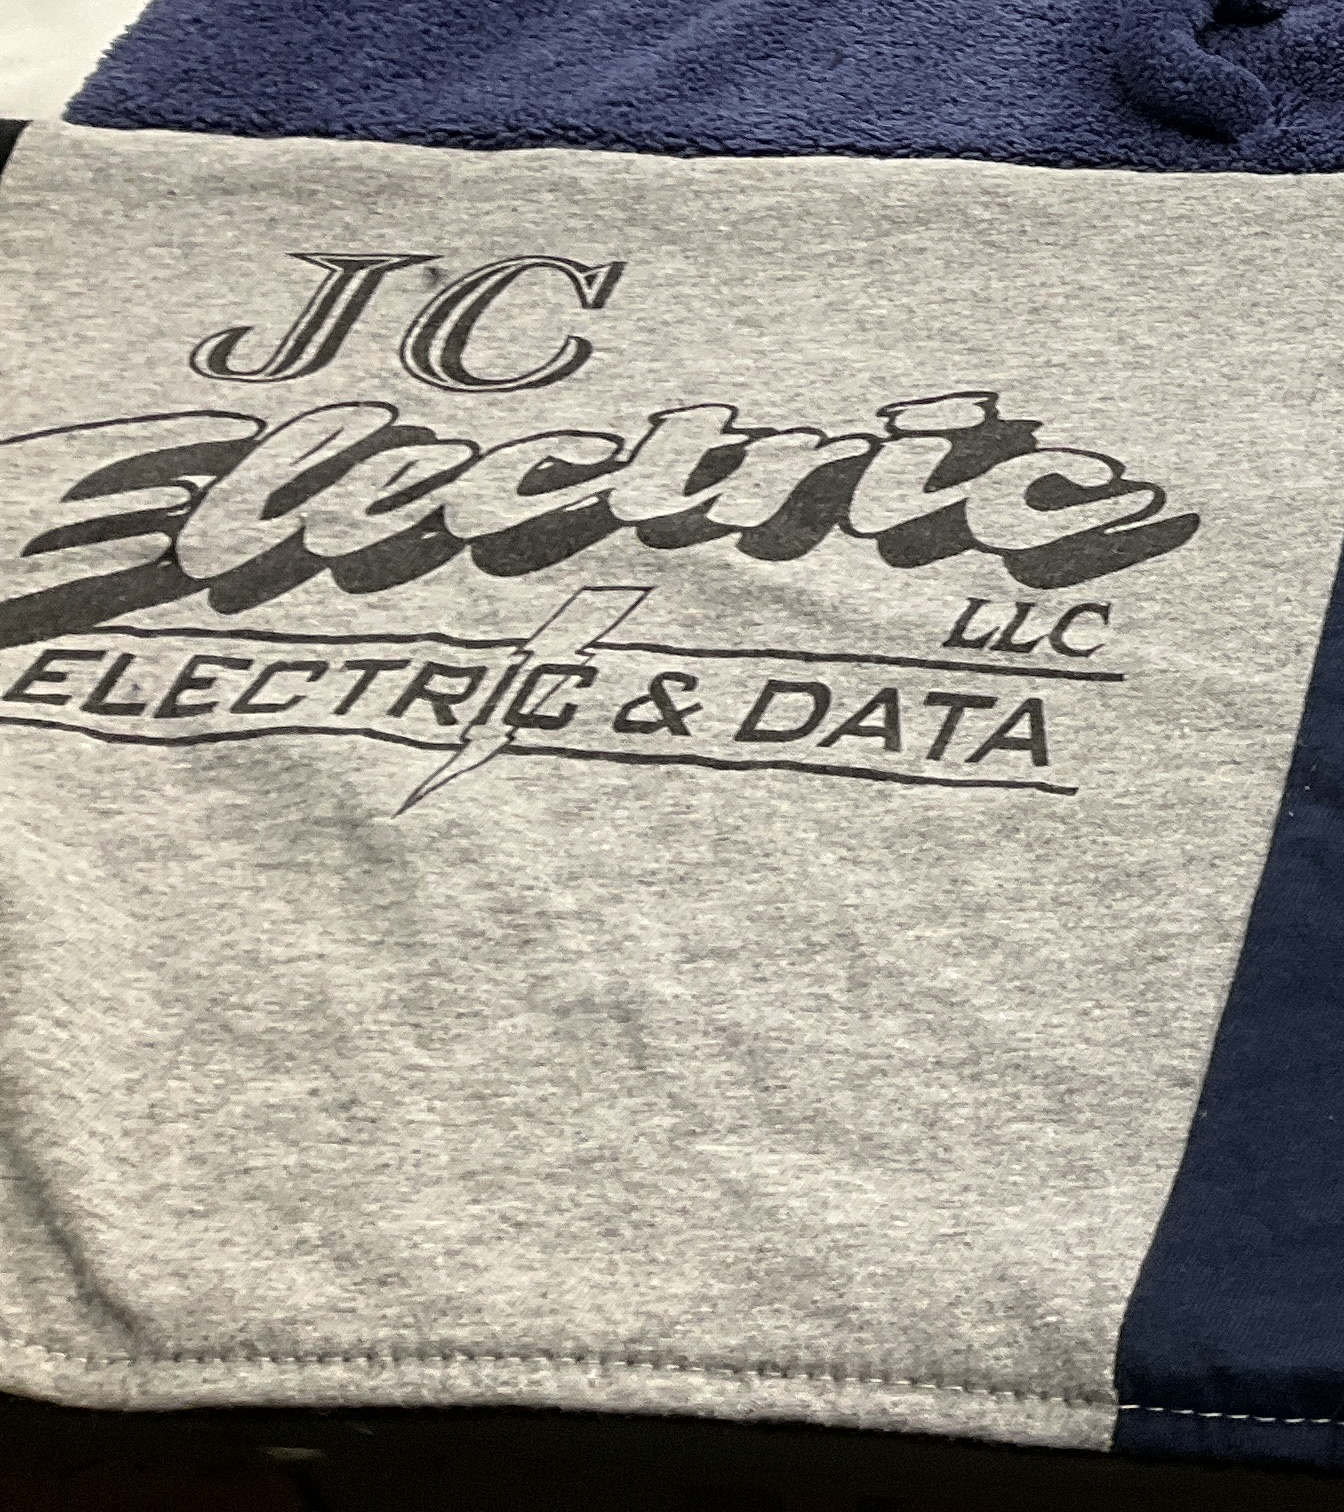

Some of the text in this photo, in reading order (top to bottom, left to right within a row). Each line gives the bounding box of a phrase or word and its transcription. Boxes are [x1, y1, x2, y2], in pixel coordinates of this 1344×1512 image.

[188, 251, 629, 394] JC
[0, 390, 1201, 648] Electric
[941, 597, 1114, 657] LLC
[14, 648, 1053, 769] ELECTRIC & DATA
